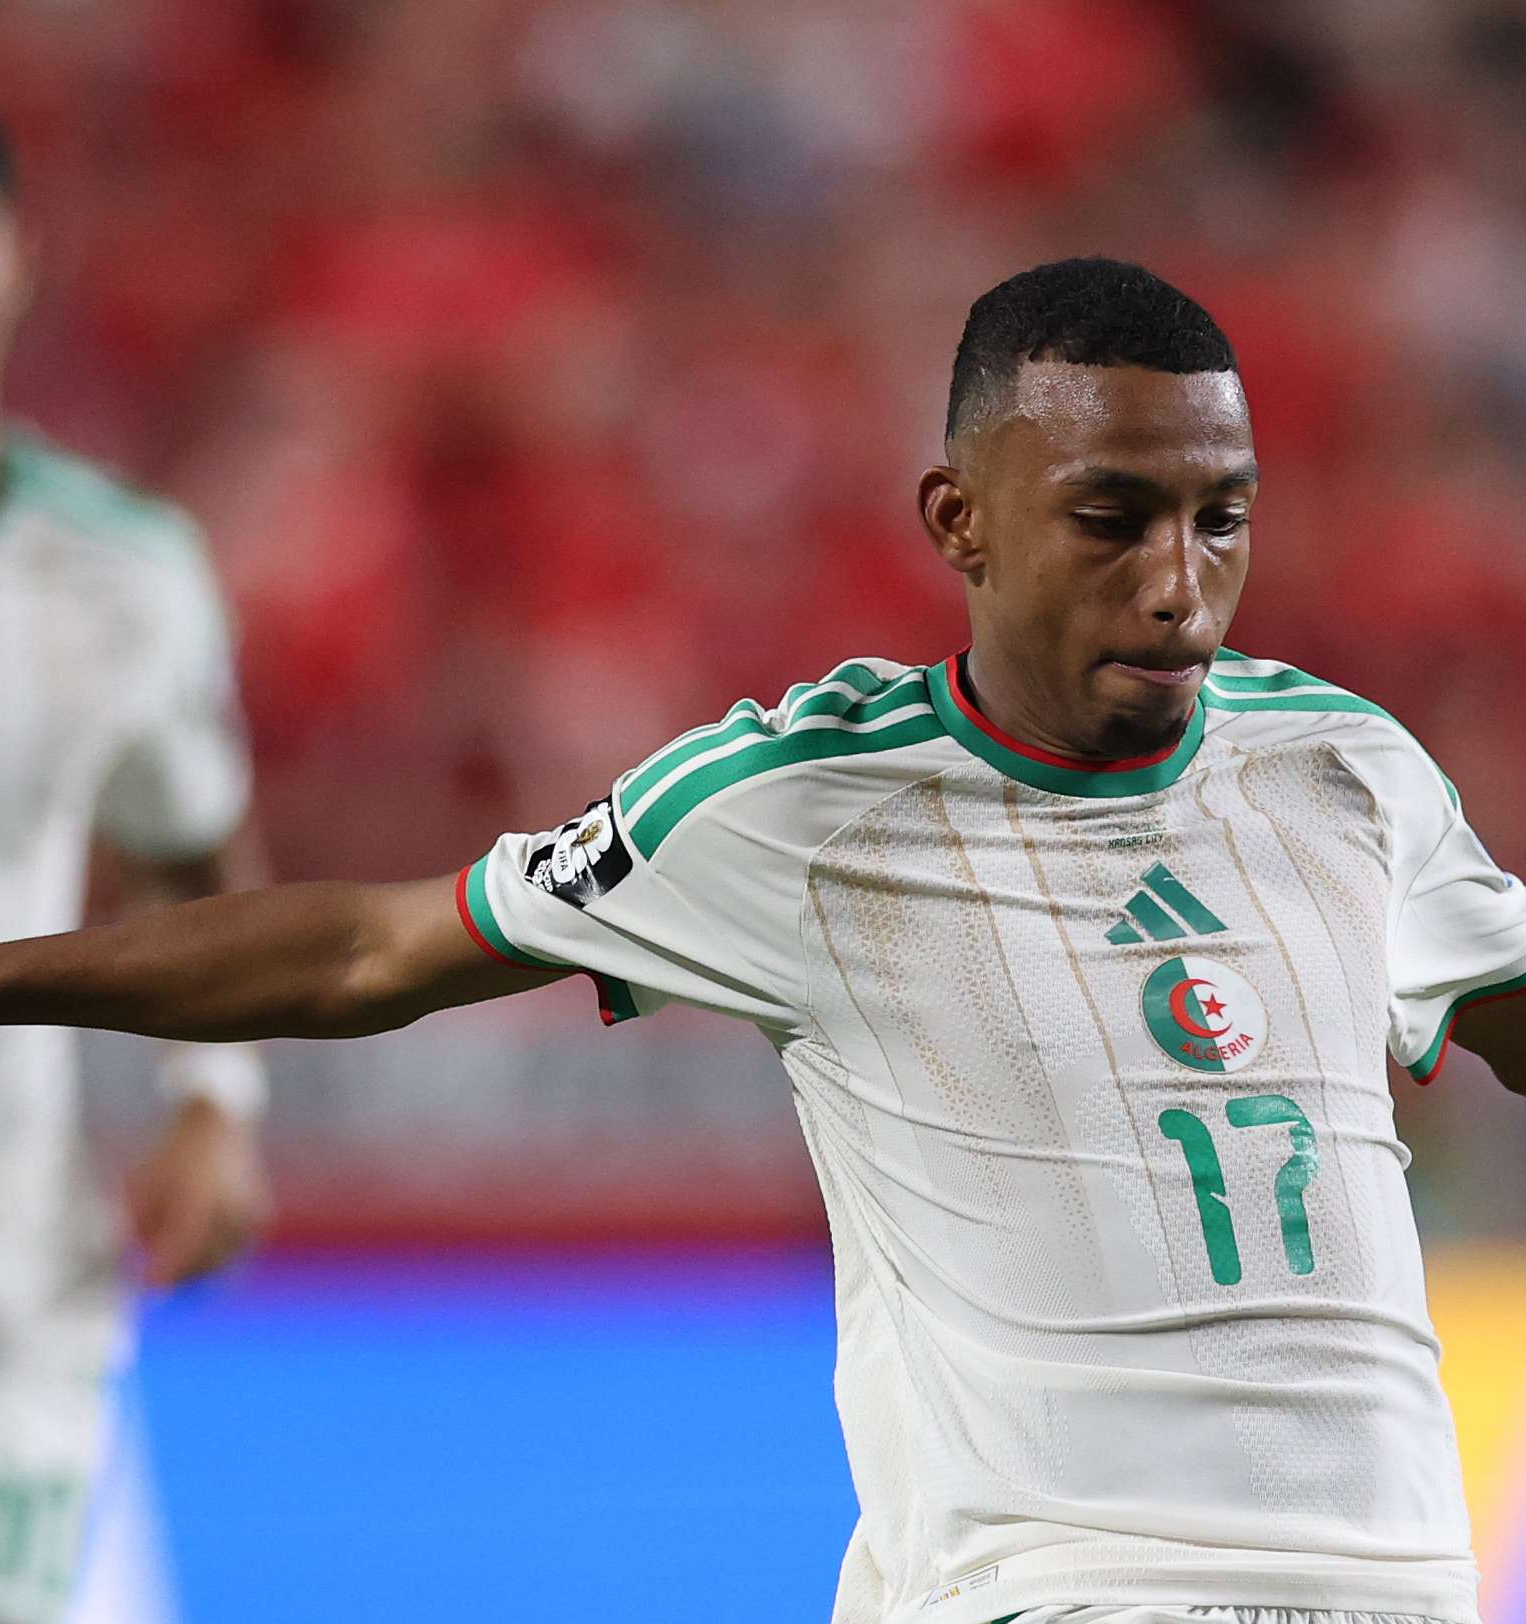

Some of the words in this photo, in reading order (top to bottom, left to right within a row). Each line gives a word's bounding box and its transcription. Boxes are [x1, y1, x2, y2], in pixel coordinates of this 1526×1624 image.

[558, 849, 569, 872] FIFA
[1180, 1032, 1255, 1062] ALGERIA
[1158, 1094, 1318, 1286] 17
